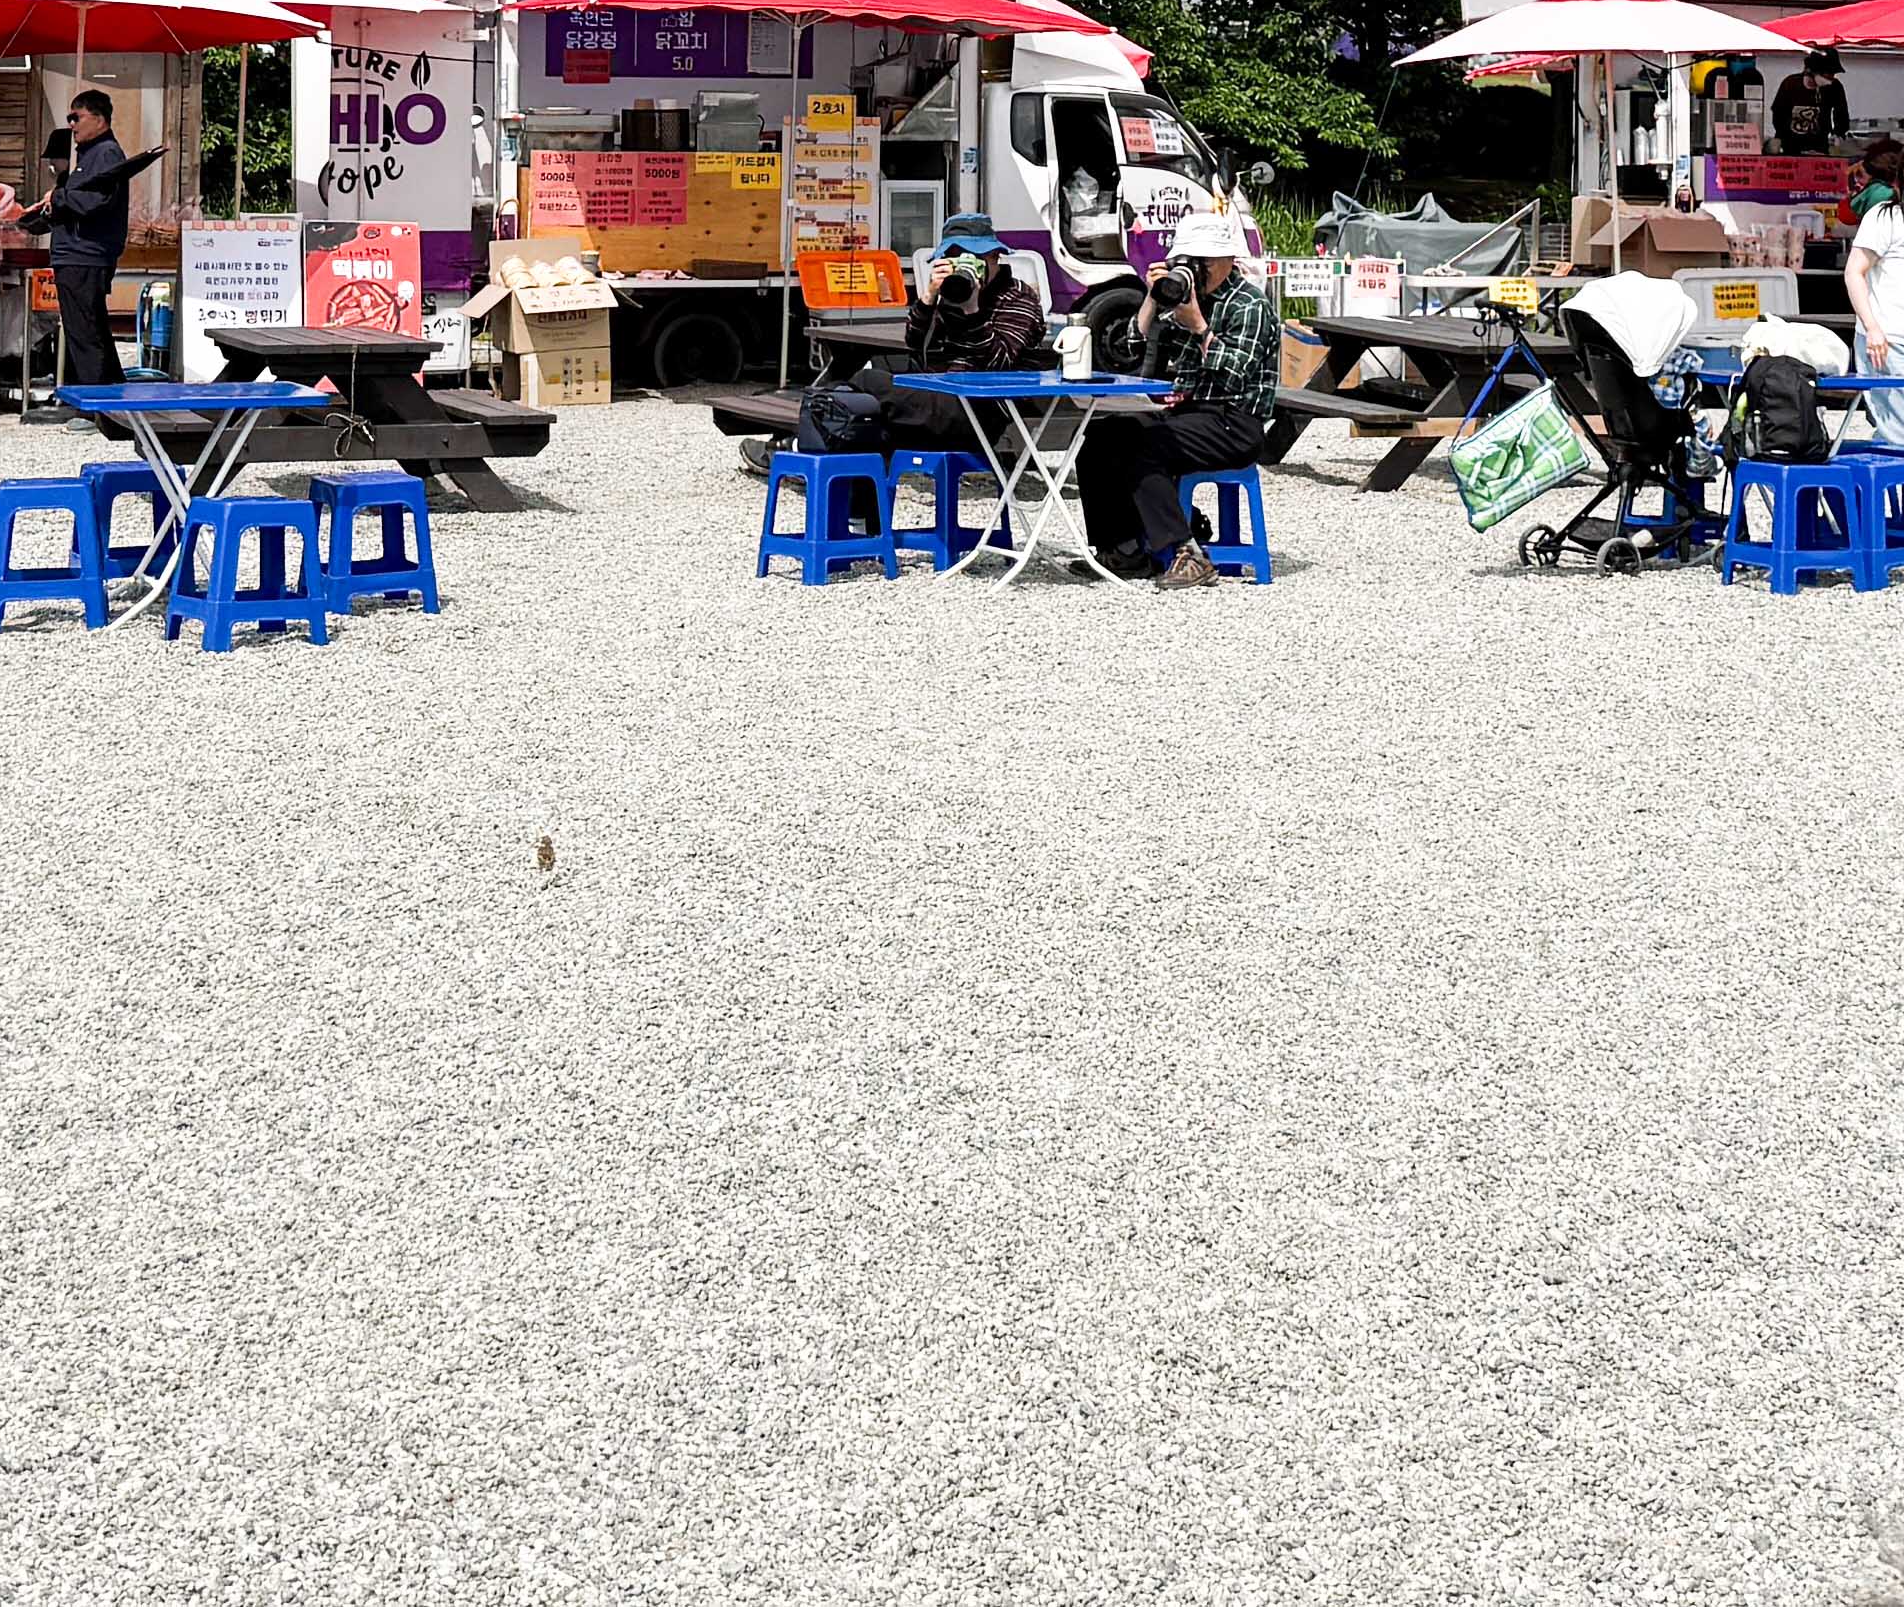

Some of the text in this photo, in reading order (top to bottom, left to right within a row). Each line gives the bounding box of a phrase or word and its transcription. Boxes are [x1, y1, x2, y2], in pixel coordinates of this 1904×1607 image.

[566, 30, 617, 50] 닭강정
[655, 31, 707, 50] 닭꼬치
[672, 56, 693, 71] 5.0
[812, 100, 845, 114] 2호차
[540, 172, 576, 182] 5000원
